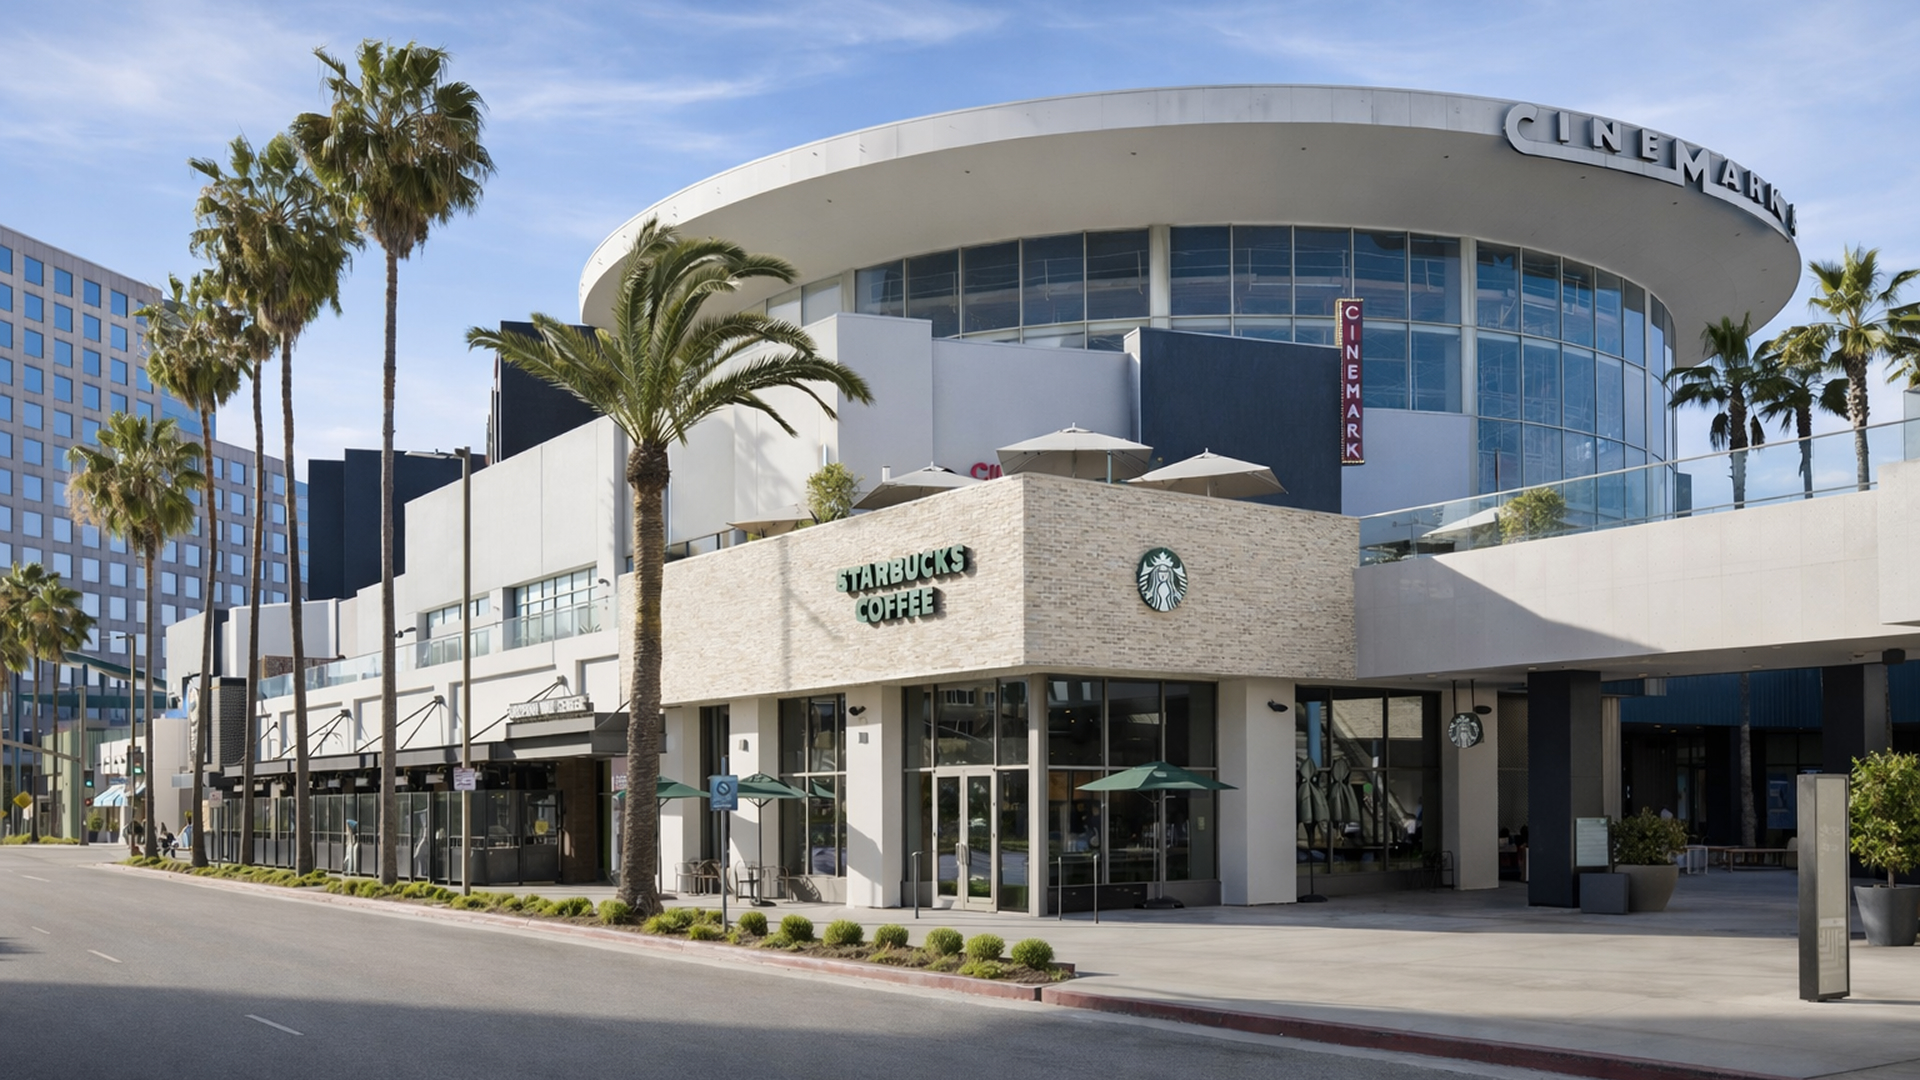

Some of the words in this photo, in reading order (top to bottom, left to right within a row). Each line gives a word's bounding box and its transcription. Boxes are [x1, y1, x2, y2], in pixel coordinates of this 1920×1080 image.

[1345, 305, 1361, 459] CINEMARK
[836, 543, 967, 593] STARBUCKS
[855, 587, 936, 623] COFFEE
